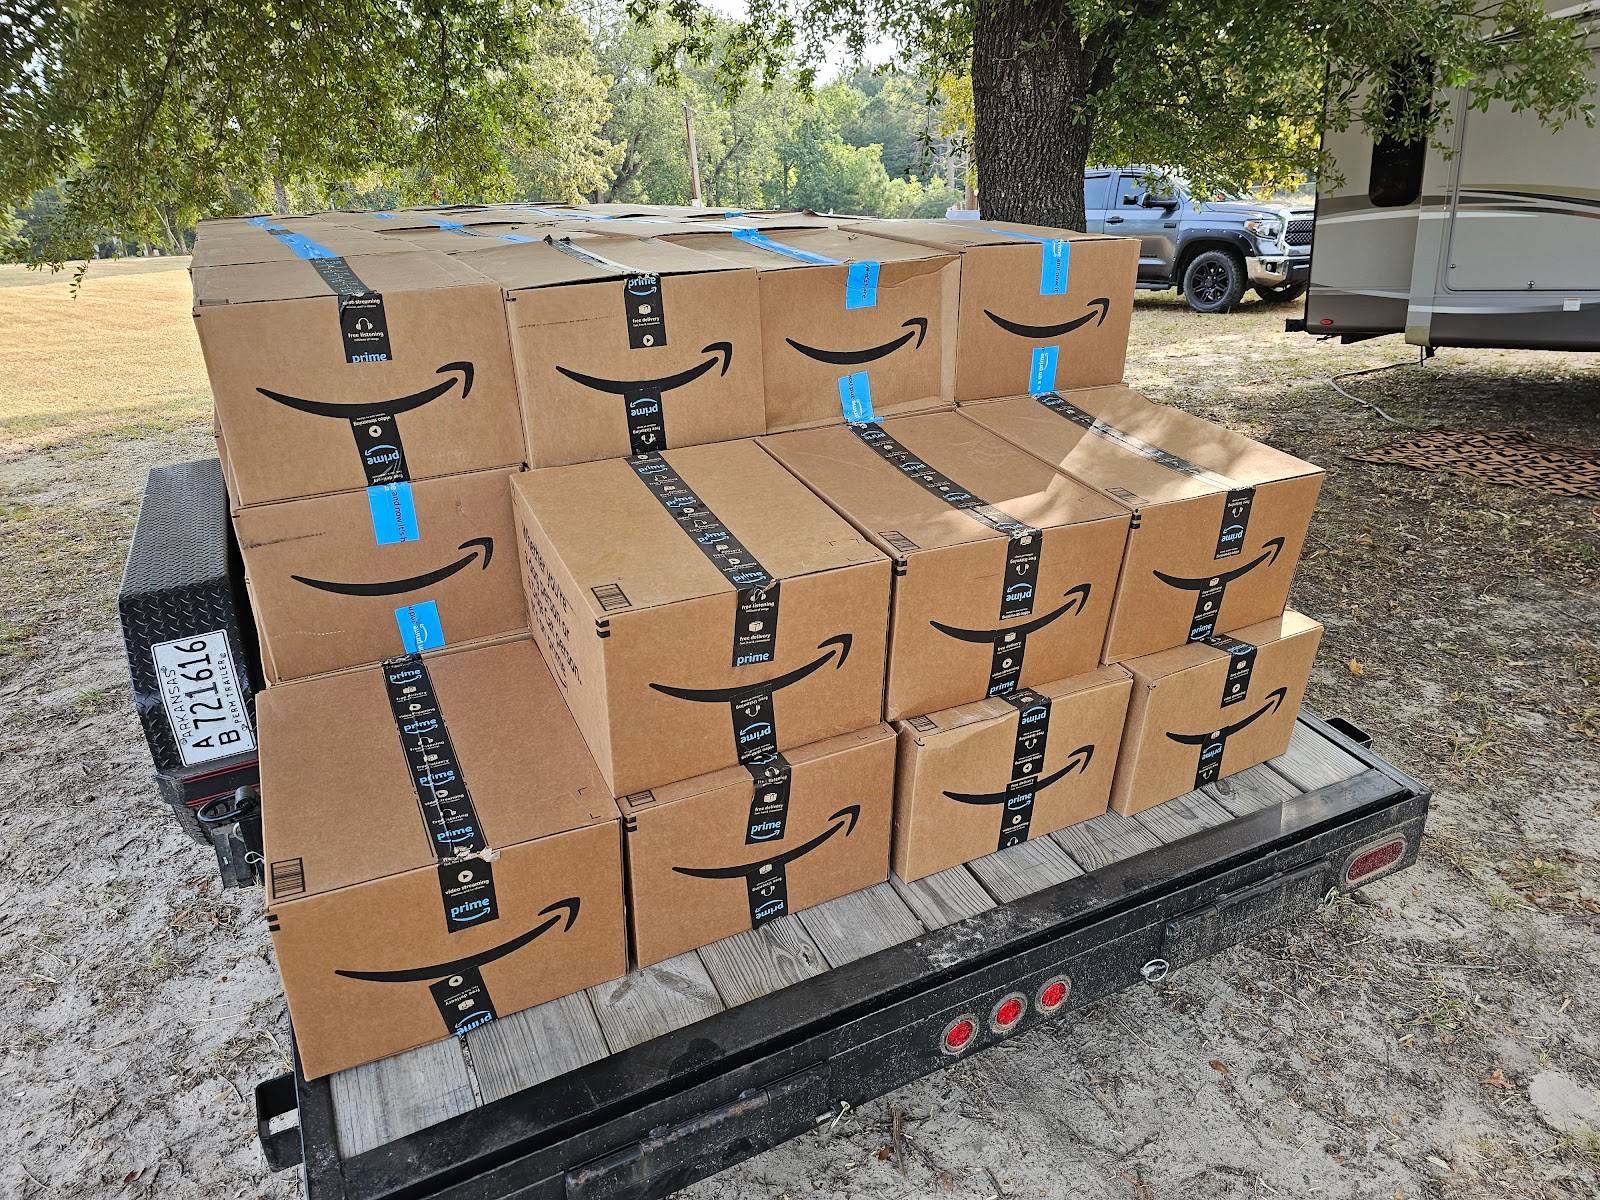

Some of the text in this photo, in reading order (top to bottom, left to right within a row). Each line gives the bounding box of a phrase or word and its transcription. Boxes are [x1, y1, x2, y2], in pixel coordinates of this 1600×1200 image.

[628, 275, 656, 289] prime
[352, 352, 387, 363] prime
[631, 404, 658, 416] prime
[367, 450, 400, 465] prime
[638, 464, 666, 473] prime
[392, 492, 401, 506] and
[666, 495, 694, 506] prime
[395, 507, 403, 523] now
[697, 531, 727, 543] prime
[1221, 530, 1243, 542] prime
[732, 571, 764, 582] prime
[1006, 589, 1033, 602] prime
[408, 611, 418, 624] and
[413, 625, 423, 645] prime
[1191, 623, 1213, 637] prime
[737, 652, 770, 666] prime
[390, 669, 421, 681] prime
[174, 641, 226, 748] A 721616
[218, 660, 242, 725] PERM TRAILER
[989, 680, 1015, 695] prime
[165, 669, 194, 738] ARKANSAS
[1021, 710, 1047, 725] prime
[404, 719, 437, 732] prime
[219, 729, 241, 745] B
[740, 726, 772, 744] prime
[419, 769, 454, 784] prime
[1008, 793, 1033, 807] prime
[436, 826, 472, 841] prime
[751, 821, 782, 835] prime
[445, 887, 461, 895] video
[461, 879, 489, 890] streaming
[450, 898, 490, 918] prime
[756, 902, 784, 920] prime
[469, 988, 480, 996] free
[445, 994, 468, 1006] delivery
[456, 1012, 492, 1036] prime
